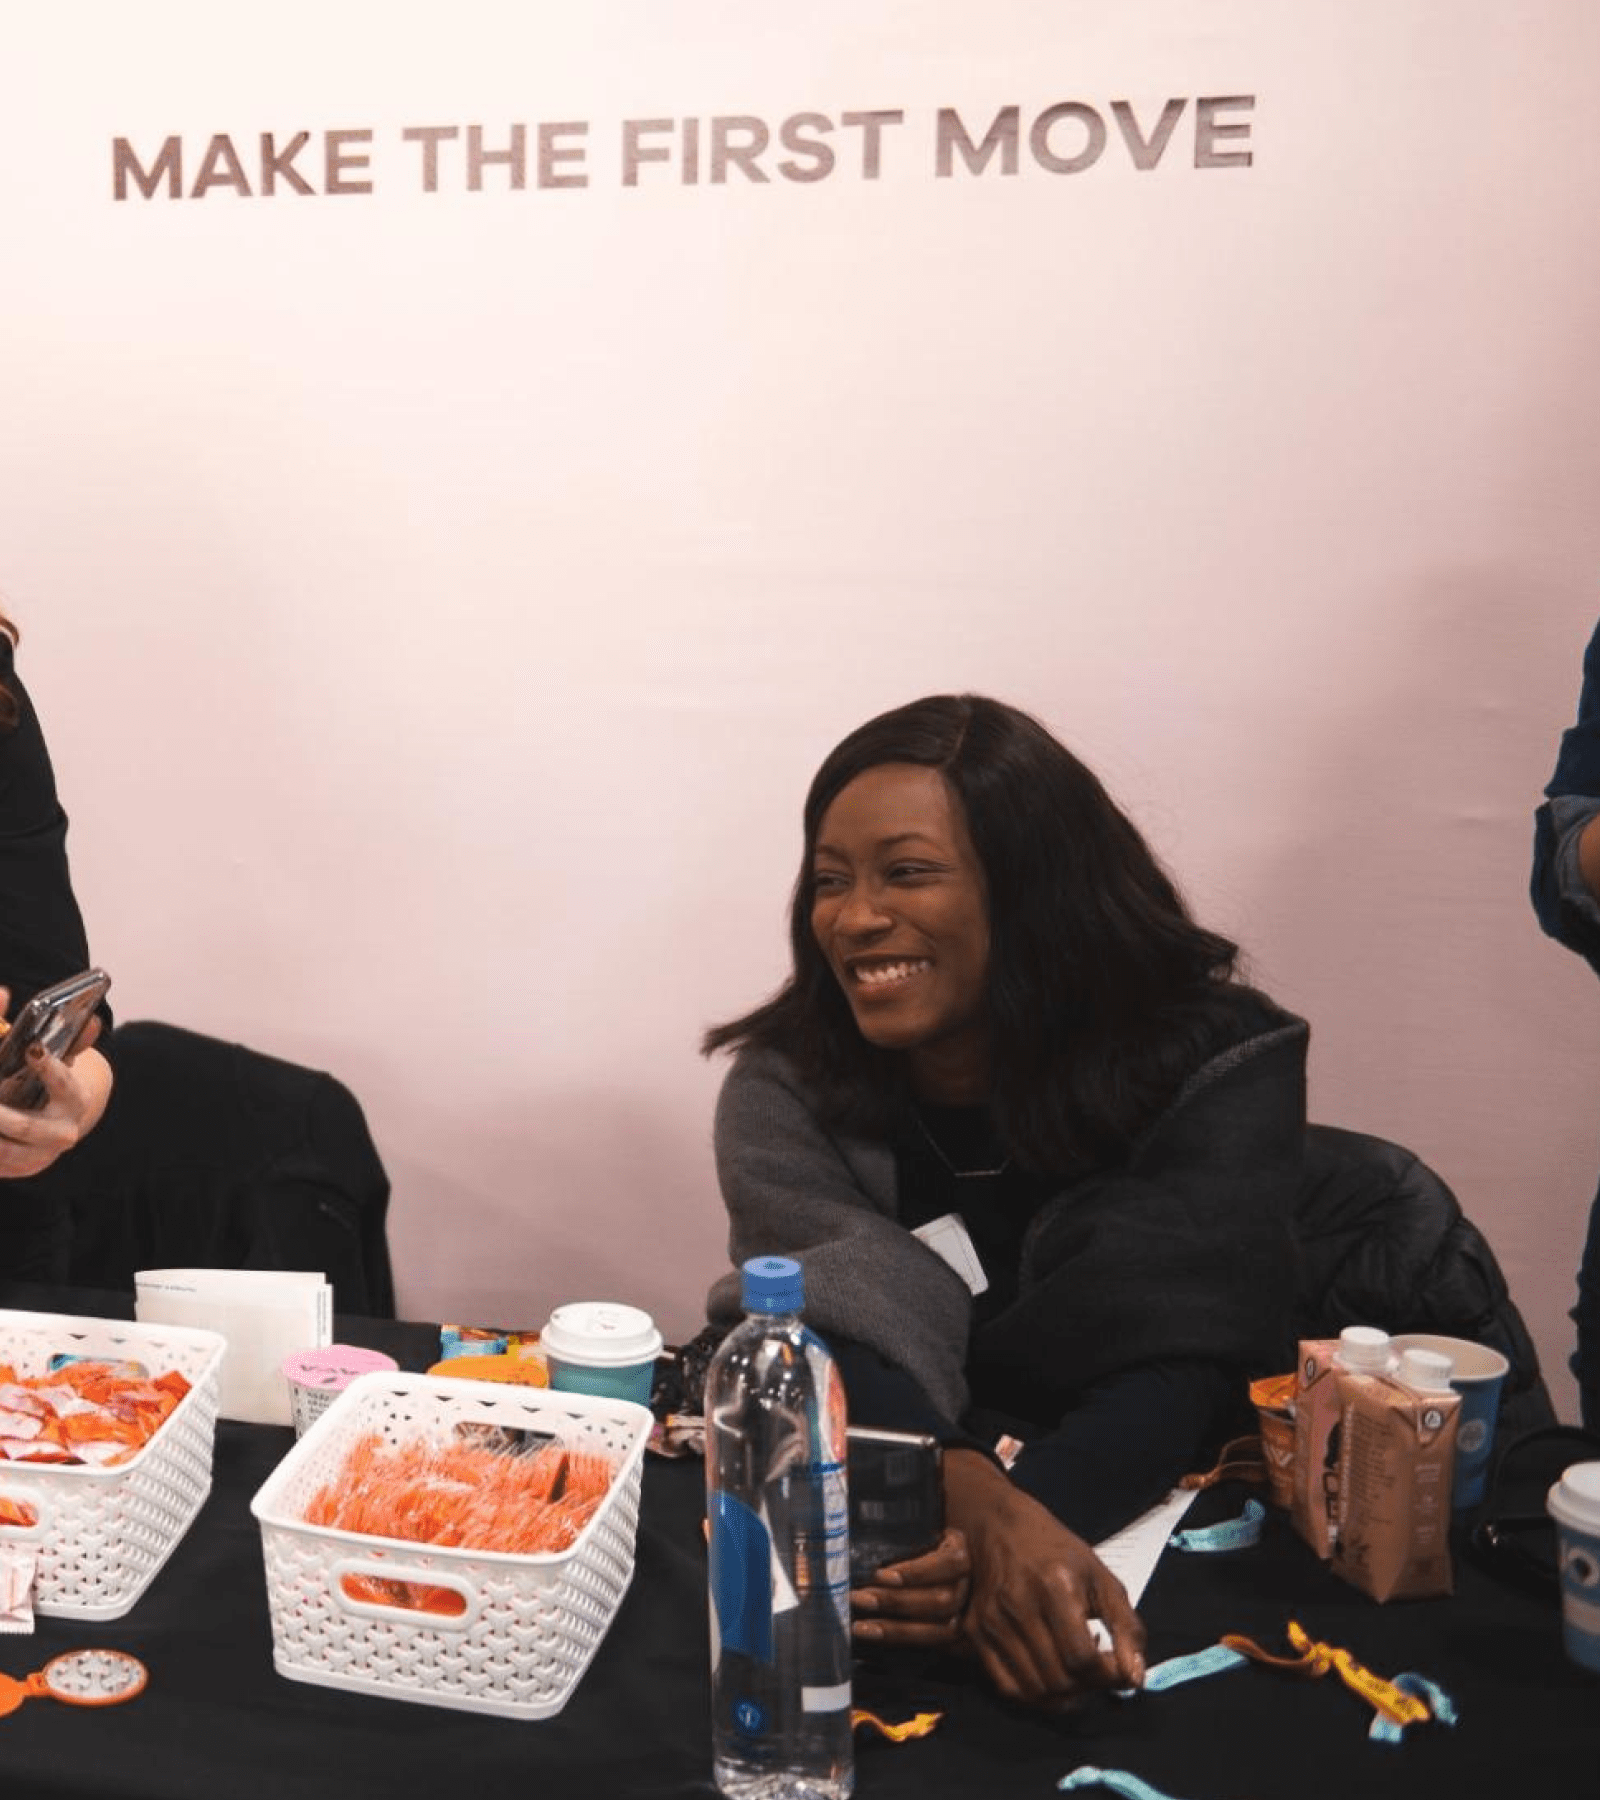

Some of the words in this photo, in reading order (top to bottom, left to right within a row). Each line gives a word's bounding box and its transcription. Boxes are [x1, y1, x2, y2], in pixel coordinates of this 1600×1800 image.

[112, 129, 374, 202] MAKE
[403, 121, 589, 194] THE
[621, 109, 904, 187] FIRST
[934, 94, 1256, 179] MOVE
